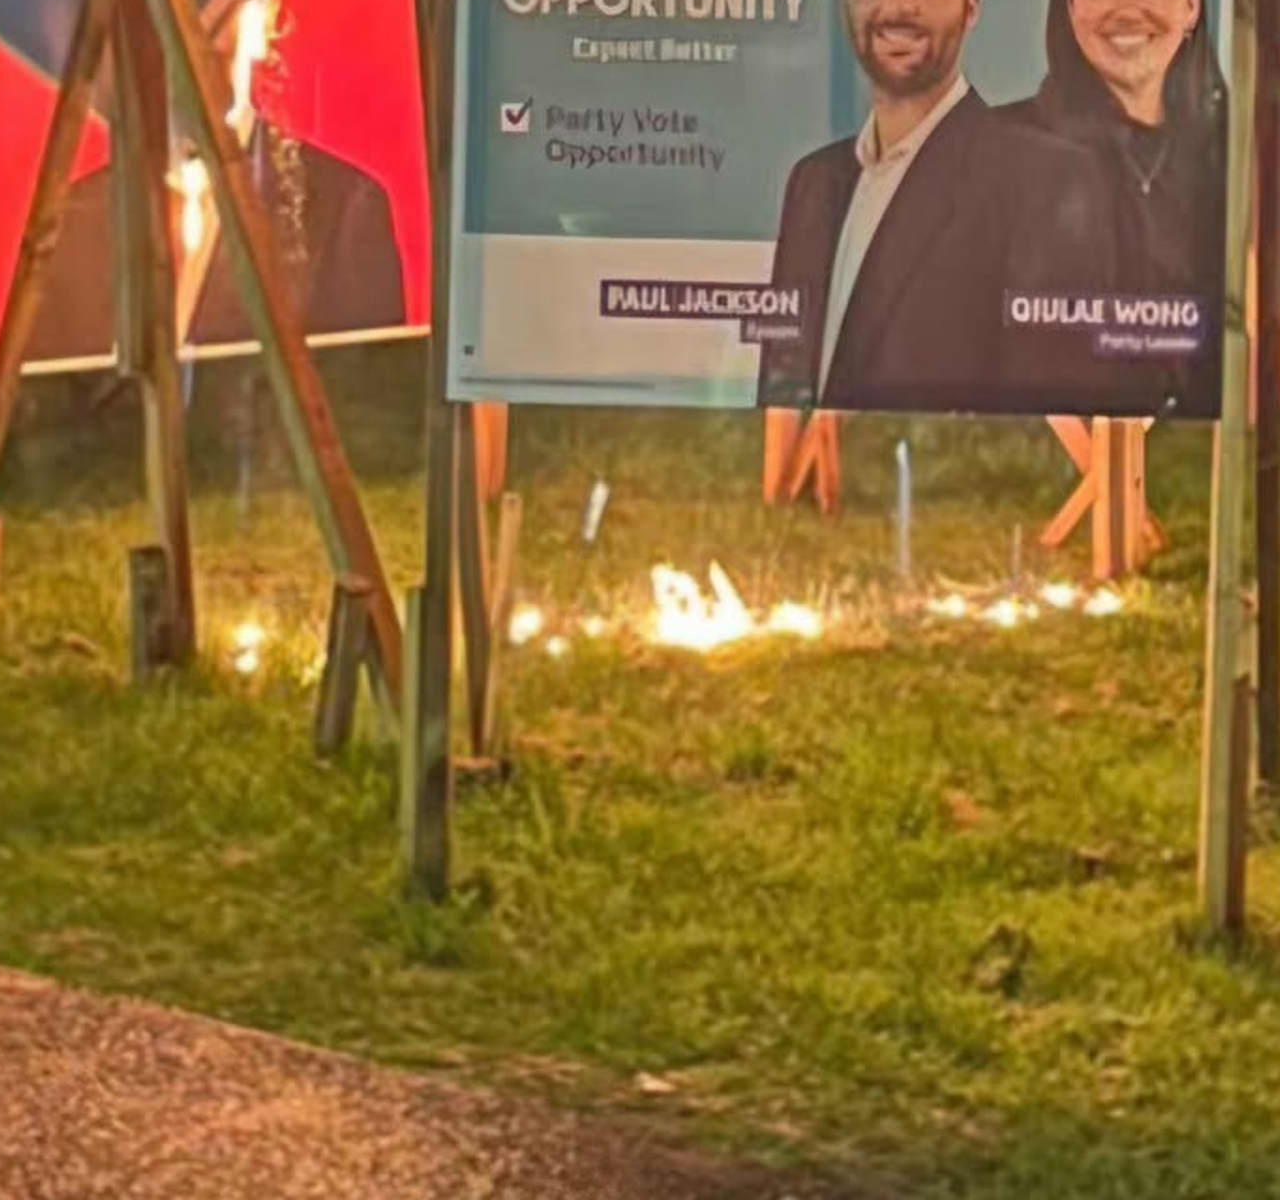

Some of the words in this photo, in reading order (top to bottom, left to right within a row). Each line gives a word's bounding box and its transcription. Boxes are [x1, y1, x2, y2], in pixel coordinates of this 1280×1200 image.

[546, 105, 625, 137] Party
[634, 106, 699, 133] Vote
[546, 138, 725, 171] Opportunity
[607, 284, 671, 312] PAUL
[679, 286, 799, 316] JACKSON
